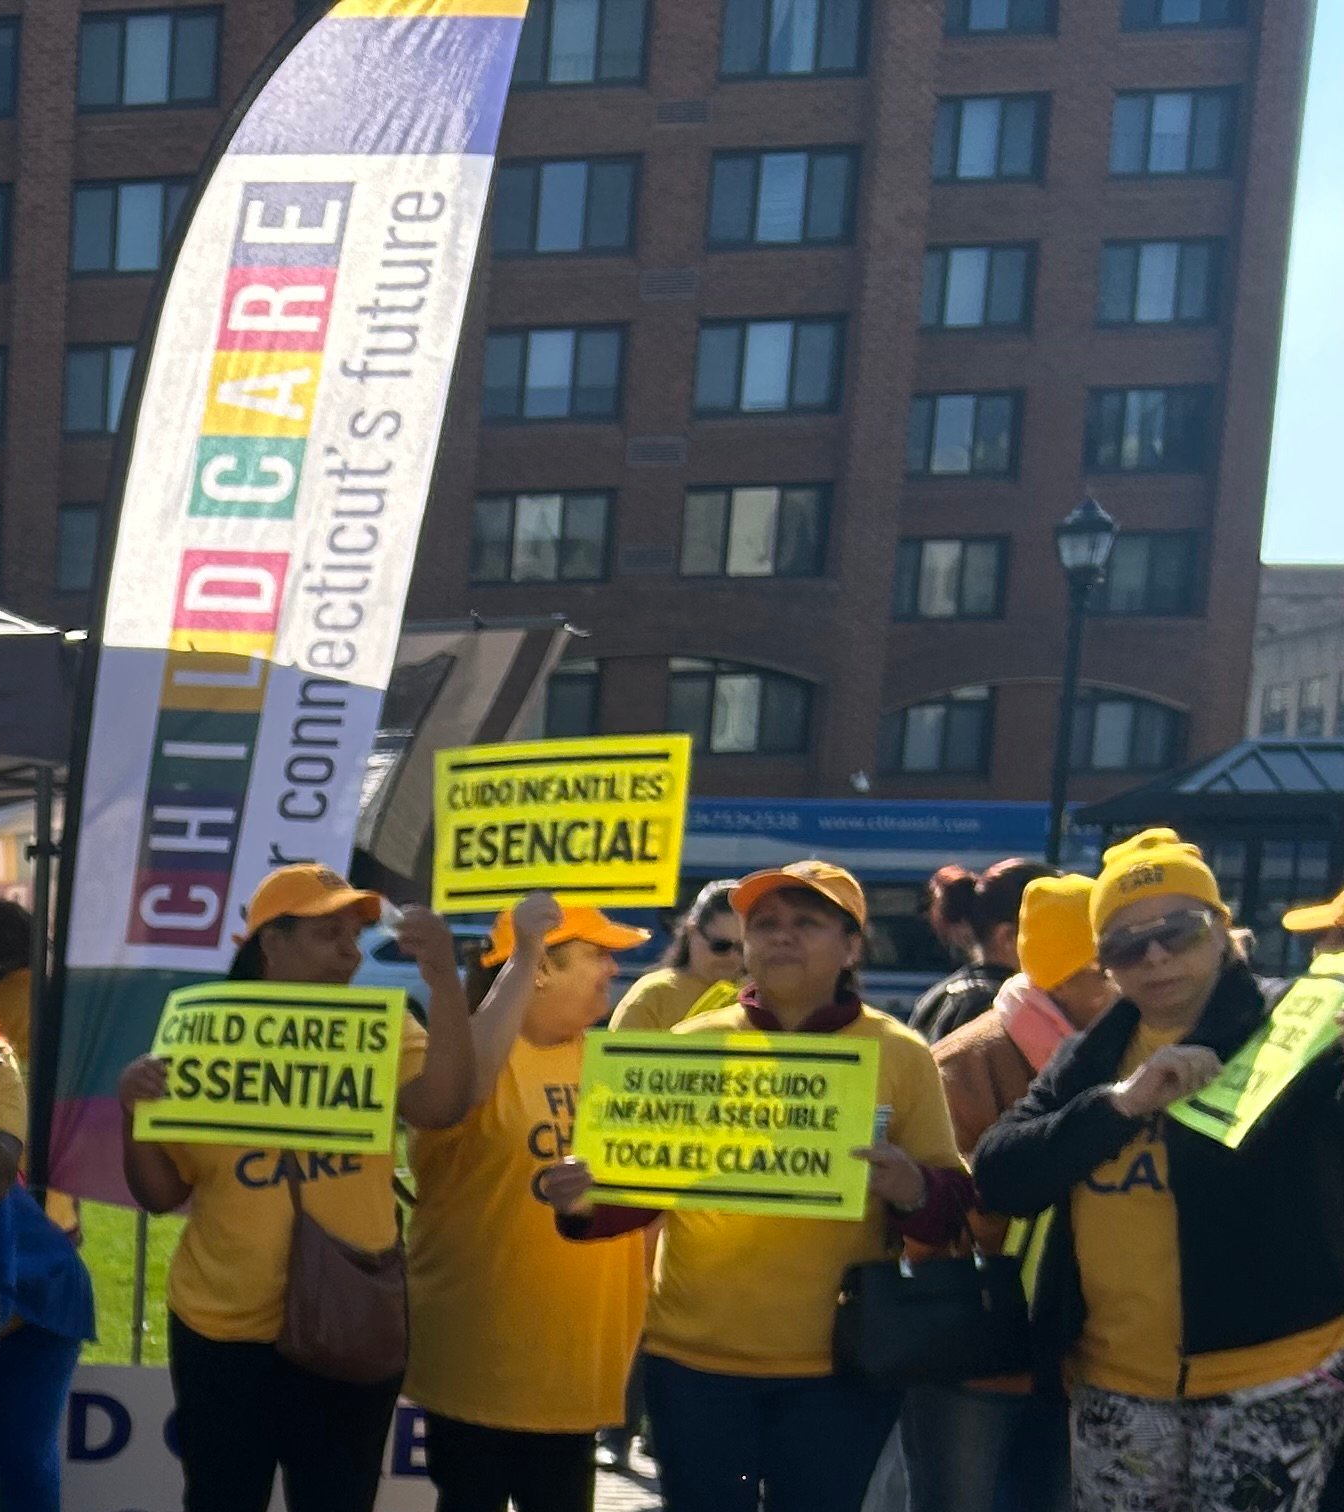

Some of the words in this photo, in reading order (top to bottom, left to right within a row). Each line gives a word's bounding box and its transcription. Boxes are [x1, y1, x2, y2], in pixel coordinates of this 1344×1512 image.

[338, 189, 446, 384] future
[201, 199, 343, 505] CARE
[278, 409, 403, 822] connecticut's
[139, 567, 277, 931] CHILD
[517, 771, 623, 803] INFANTIL
[454, 819, 659, 869] ESENCIAL
[161, 1011, 246, 1046] CHILD
[253, 1013, 348, 1053] CARE
[355, 1017, 389, 1053] IS
[543, 1083, 579, 1117] FI
[647, 1069, 752, 1098] QUIERES
[752, 1072, 828, 1100] CUIDO
[604, 1098, 698, 1127] INFANTIL
[706, 1101, 840, 1131] ASEQUIBLE
[603, 1138, 671, 1168] TOCA
[677, 1145, 707, 1171] EL
[715, 1145, 833, 1178] CLAXON
